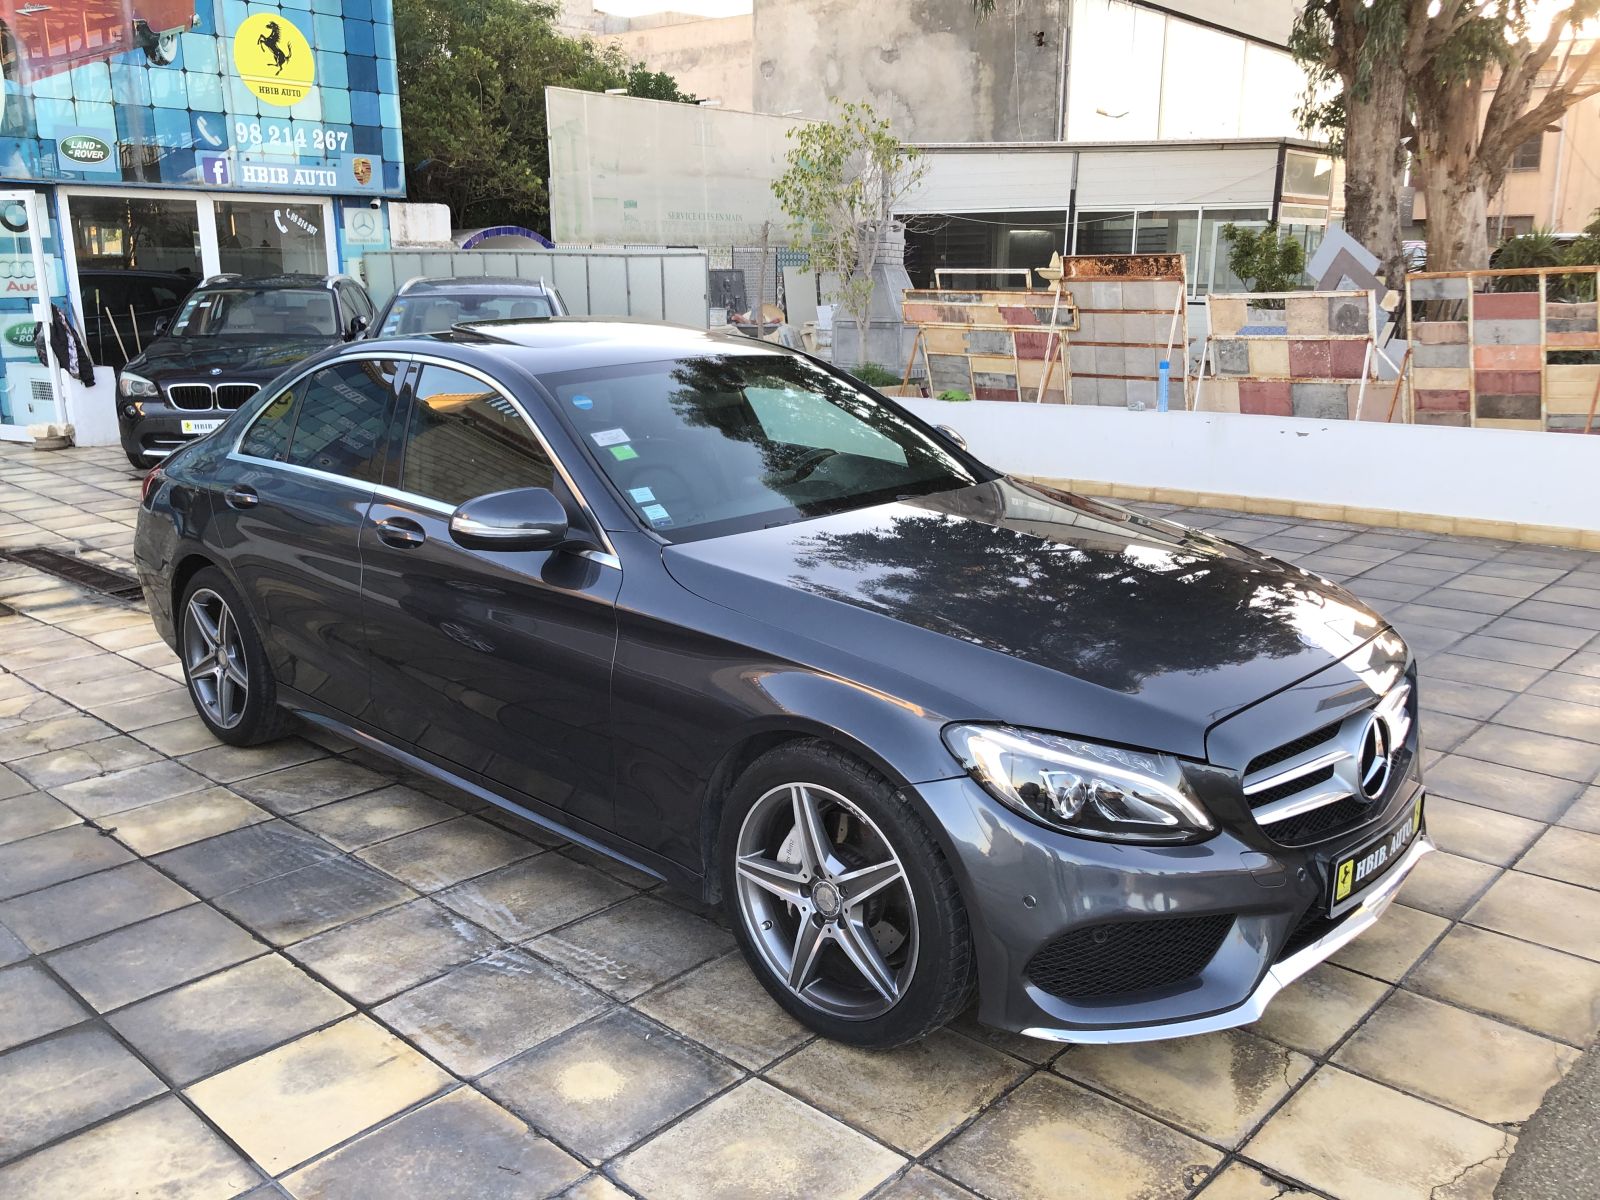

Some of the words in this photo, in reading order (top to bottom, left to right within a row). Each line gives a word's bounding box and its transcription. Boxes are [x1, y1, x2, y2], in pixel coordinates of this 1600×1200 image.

[259, 86, 279, 95] HBIB
[281, 89, 301, 97] AUTO
[235, 122, 263, 145] 98
[269, 125, 307, 148] 214
[312, 128, 348, 151] 267
[74, 149, 104, 159] ROVER
[242, 165, 289, 185] HBIB
[293, 168, 337, 187] AUTO
[15, 326, 34, 335] LAN
[1355, 845, 1387, 882] HBIB
[1390, 817, 1413, 857] AUTO
